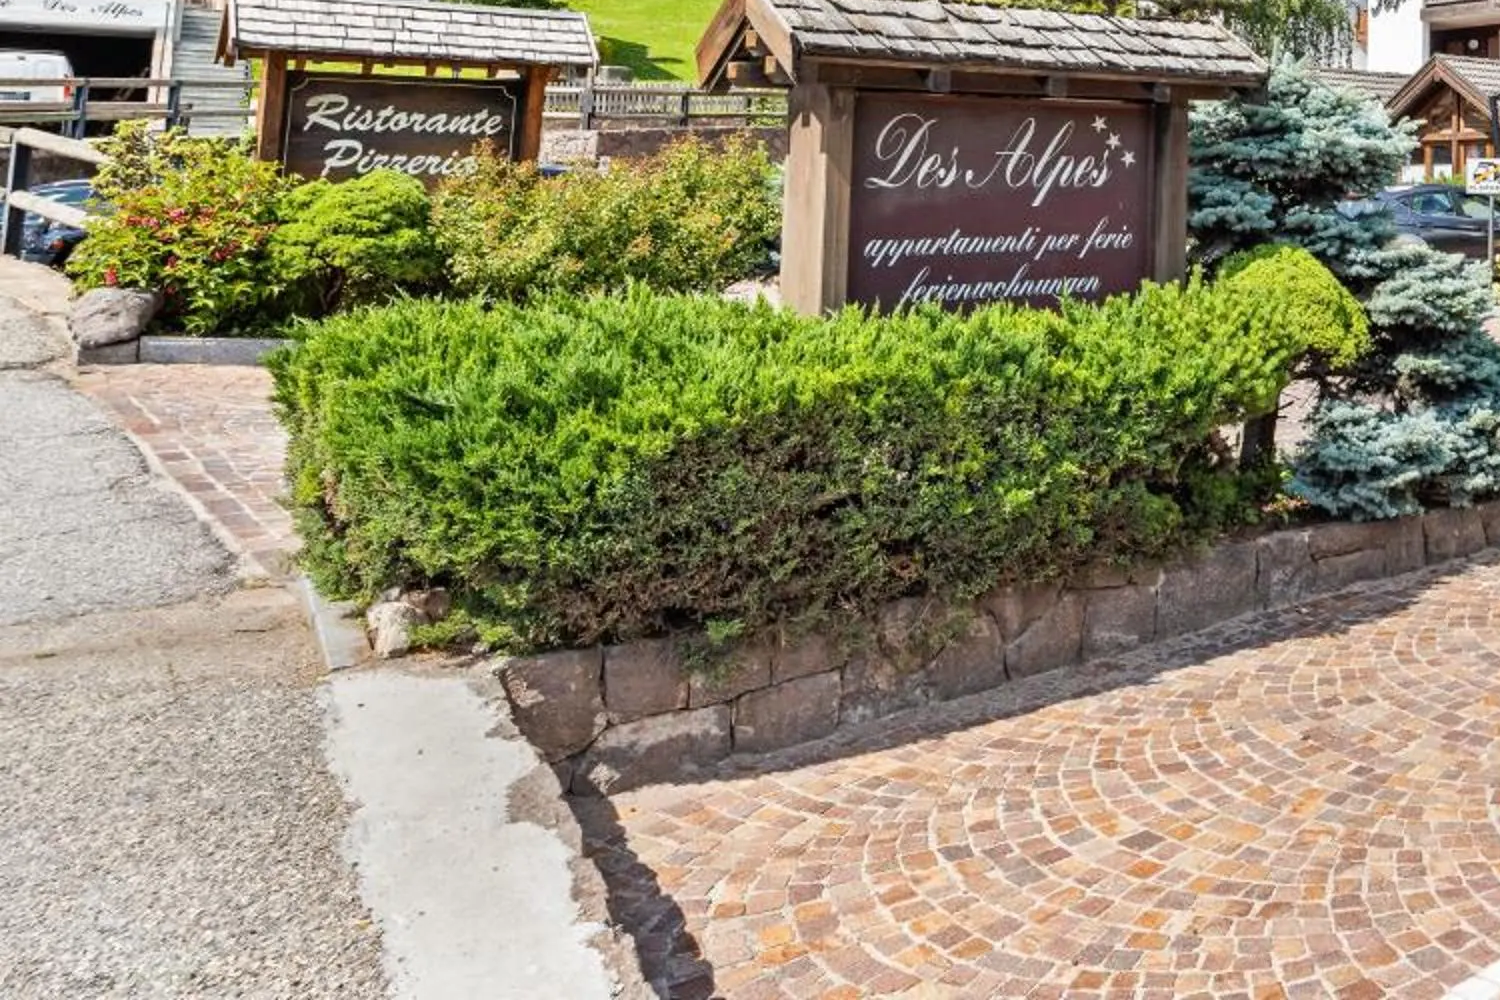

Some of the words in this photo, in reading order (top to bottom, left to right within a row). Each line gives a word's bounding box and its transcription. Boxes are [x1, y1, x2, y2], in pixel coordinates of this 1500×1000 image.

[91, 1, 143, 18] Alpes
[303, 93, 503, 135] Ristorante
[864, 112, 961, 189] Des
[964, 116, 1112, 207] Alpes
[864, 226, 1041, 268] appartamenti
[1033, 232, 1080, 261] per
[1077, 215, 1135, 260] ferie
[896, 264, 1100, 306] ferienwohnungen
